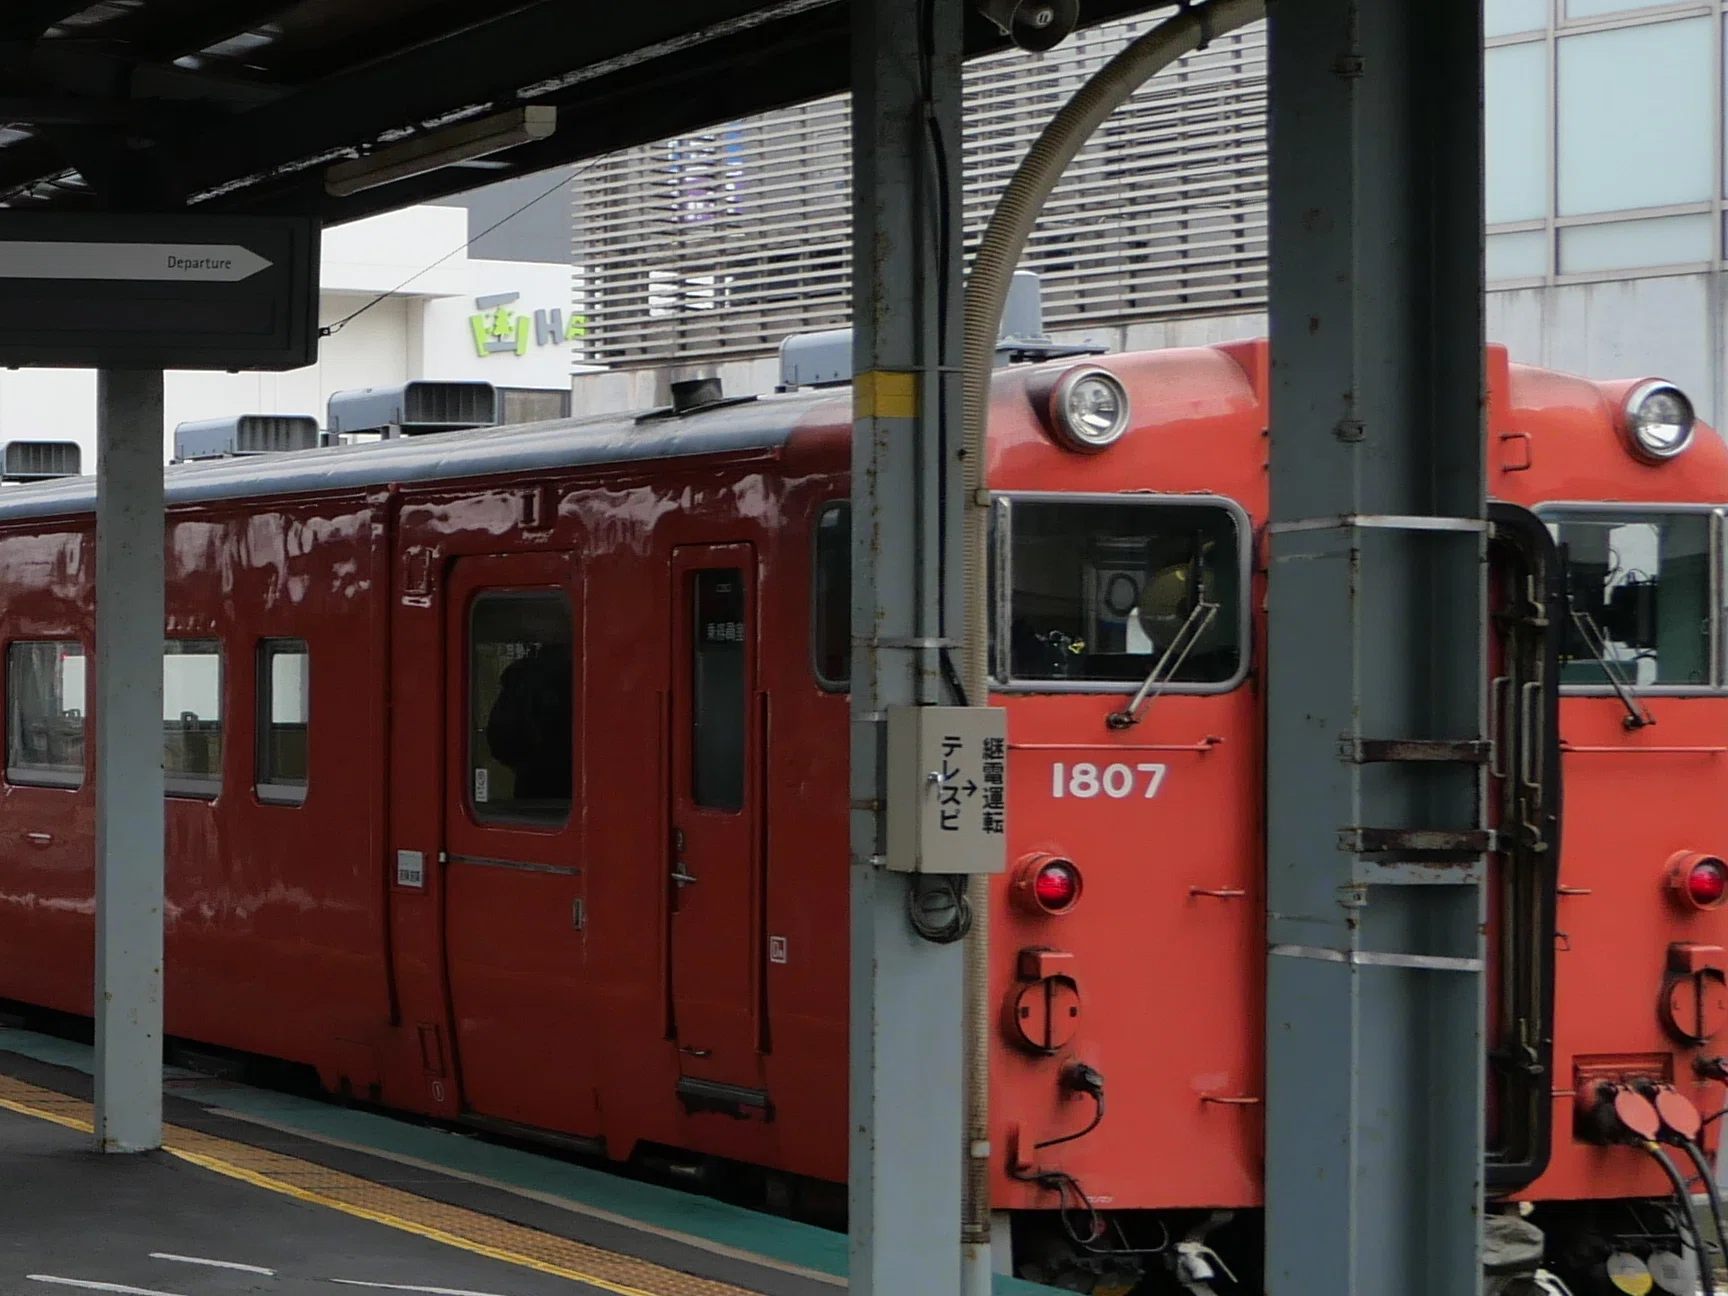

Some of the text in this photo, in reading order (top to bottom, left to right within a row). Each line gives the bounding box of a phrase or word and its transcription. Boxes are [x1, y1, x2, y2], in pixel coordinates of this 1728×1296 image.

[167, 254, 232, 271] Departure
[940, 736, 962, 831] テレスピ
[1052, 763, 1166, 798] 1807
